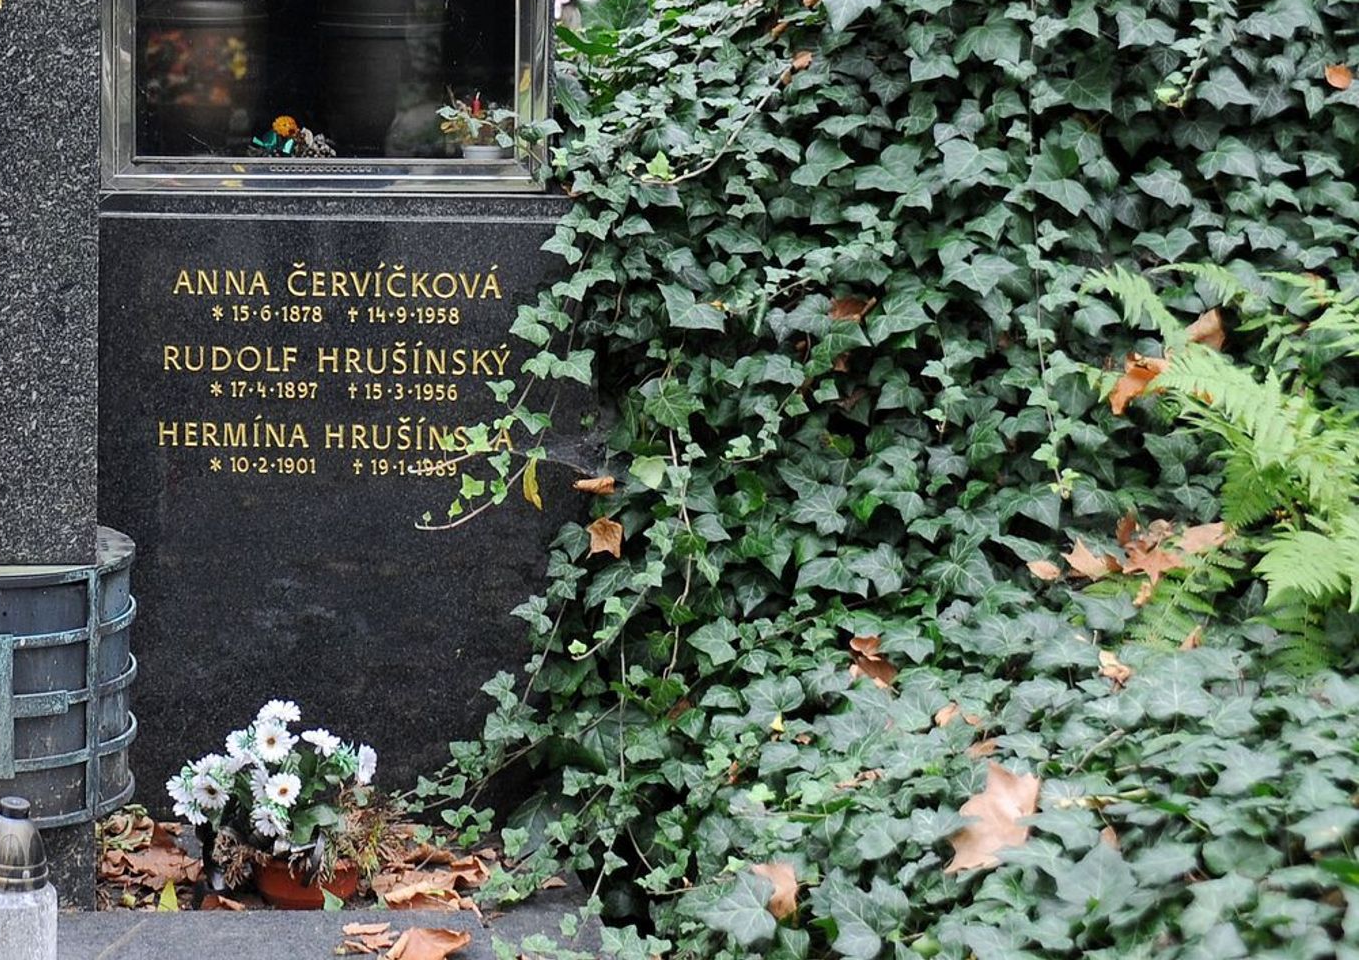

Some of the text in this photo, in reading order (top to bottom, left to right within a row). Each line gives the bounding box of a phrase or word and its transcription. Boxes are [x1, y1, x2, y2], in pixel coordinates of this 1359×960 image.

[173, 262, 503, 300] ANNA ČERVÍČKOVÁ
[163, 341, 512, 376] RUDOLF HRUŠÍNSKÝ
[158, 414, 310, 449] HERMÍNA
